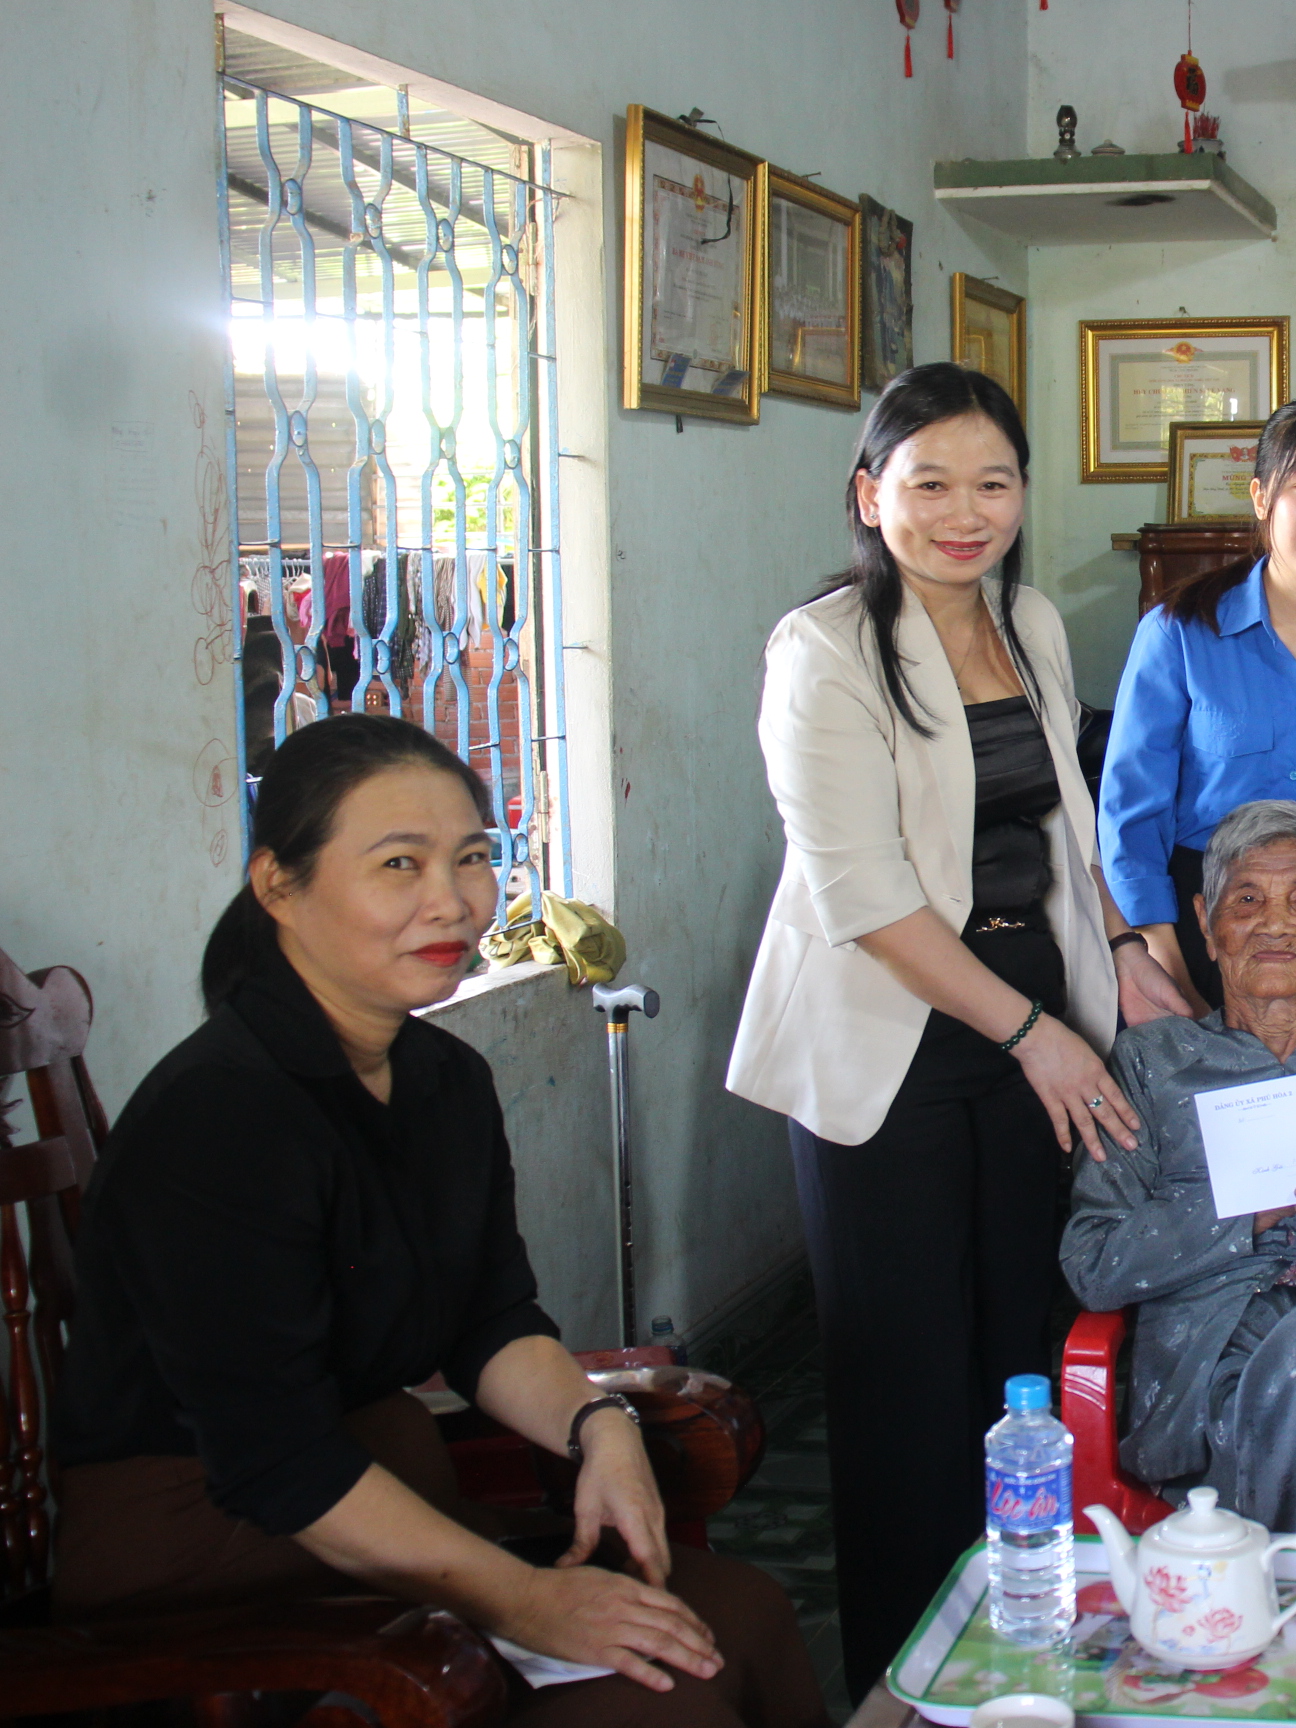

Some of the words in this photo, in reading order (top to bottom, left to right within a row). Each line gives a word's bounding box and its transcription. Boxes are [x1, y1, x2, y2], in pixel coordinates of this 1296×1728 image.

[1214, 1101, 1234, 1111] ĐẢNG
[1246, 1097, 1256, 1105] XÃ
[1256, 1093, 1271, 1103] PHÚ
[1272, 1091, 1287, 1099] HÒA
[991, 1477, 1025, 1523] Lộc
